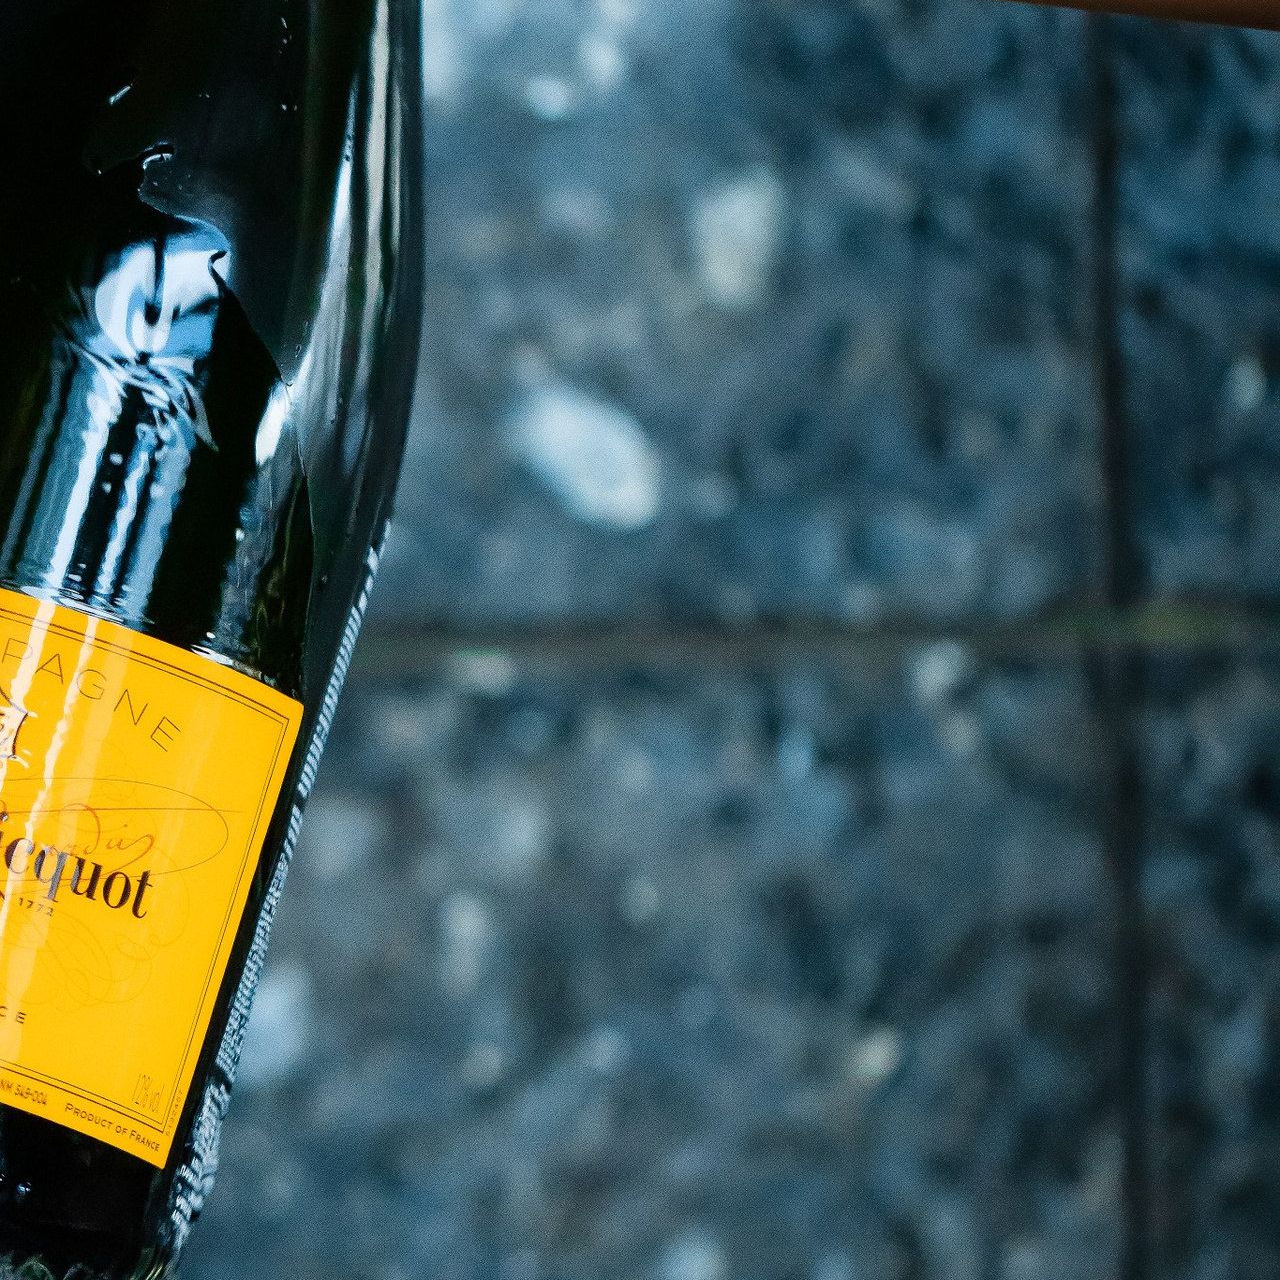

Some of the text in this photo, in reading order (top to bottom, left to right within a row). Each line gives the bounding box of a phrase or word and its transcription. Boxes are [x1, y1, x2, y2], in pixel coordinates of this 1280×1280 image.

[18, 897, 55, 917] 1772
[64, 1102, 161, 1153] PRODUCT OF FRANCE
